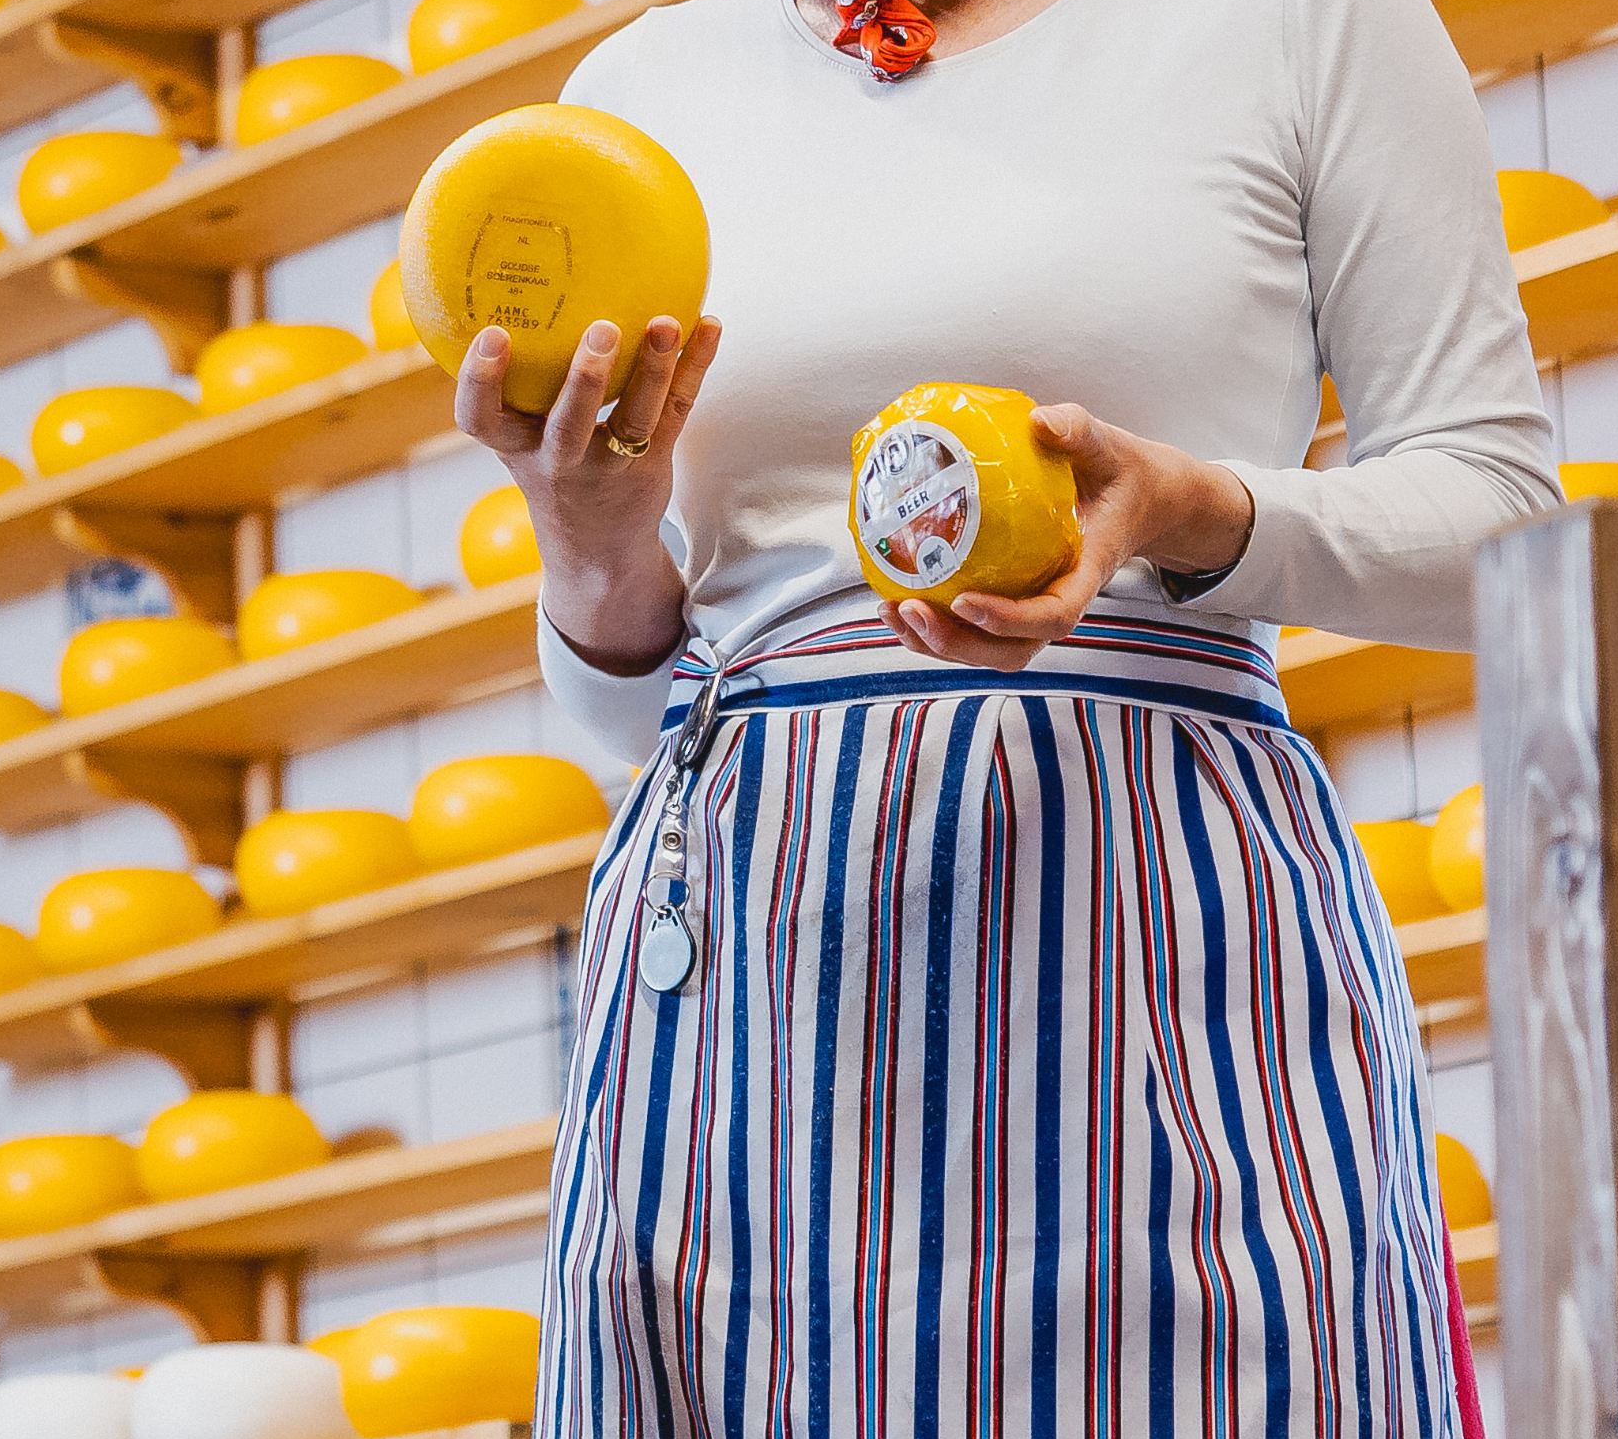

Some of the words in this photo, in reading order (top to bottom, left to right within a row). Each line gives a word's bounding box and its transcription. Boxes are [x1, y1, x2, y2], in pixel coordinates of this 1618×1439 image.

[500, 261, 540, 273] GOUDSE
[495, 305, 530, 318] AAMC
[487, 314, 539, 330] 763589
[897, 491, 930, 519] BEER
